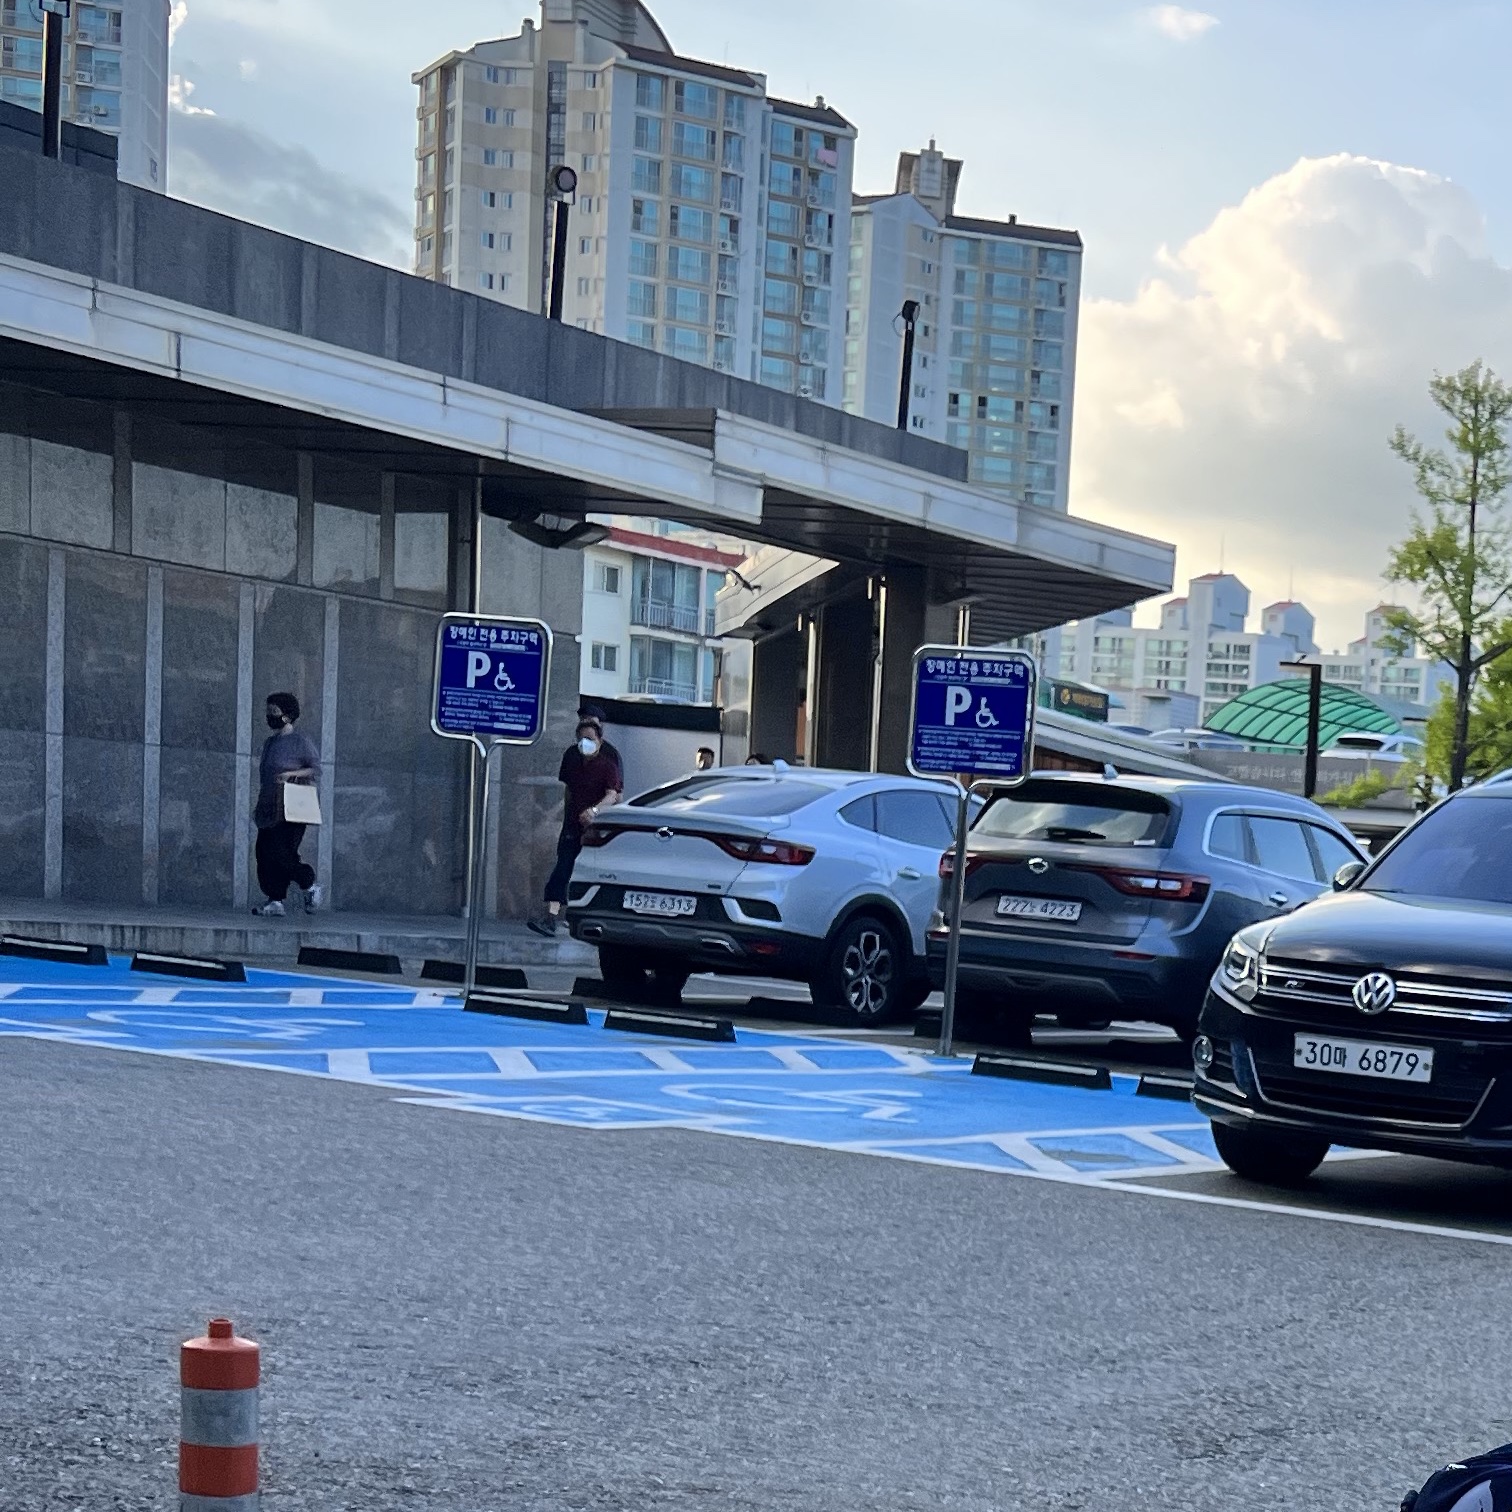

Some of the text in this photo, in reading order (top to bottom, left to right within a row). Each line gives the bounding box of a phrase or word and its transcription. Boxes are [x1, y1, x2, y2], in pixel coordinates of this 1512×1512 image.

[449, 625, 477, 640] 장애인
[480, 628, 497, 643] 전용
[501, 629, 538, 646] 주차구역
[466, 650, 492, 689] P
[926, 659, 1024, 678] 장애인 전용 주차구역
[944, 685, 973, 726] P
[1305, 1041, 1419, 1076] 30마 6879
